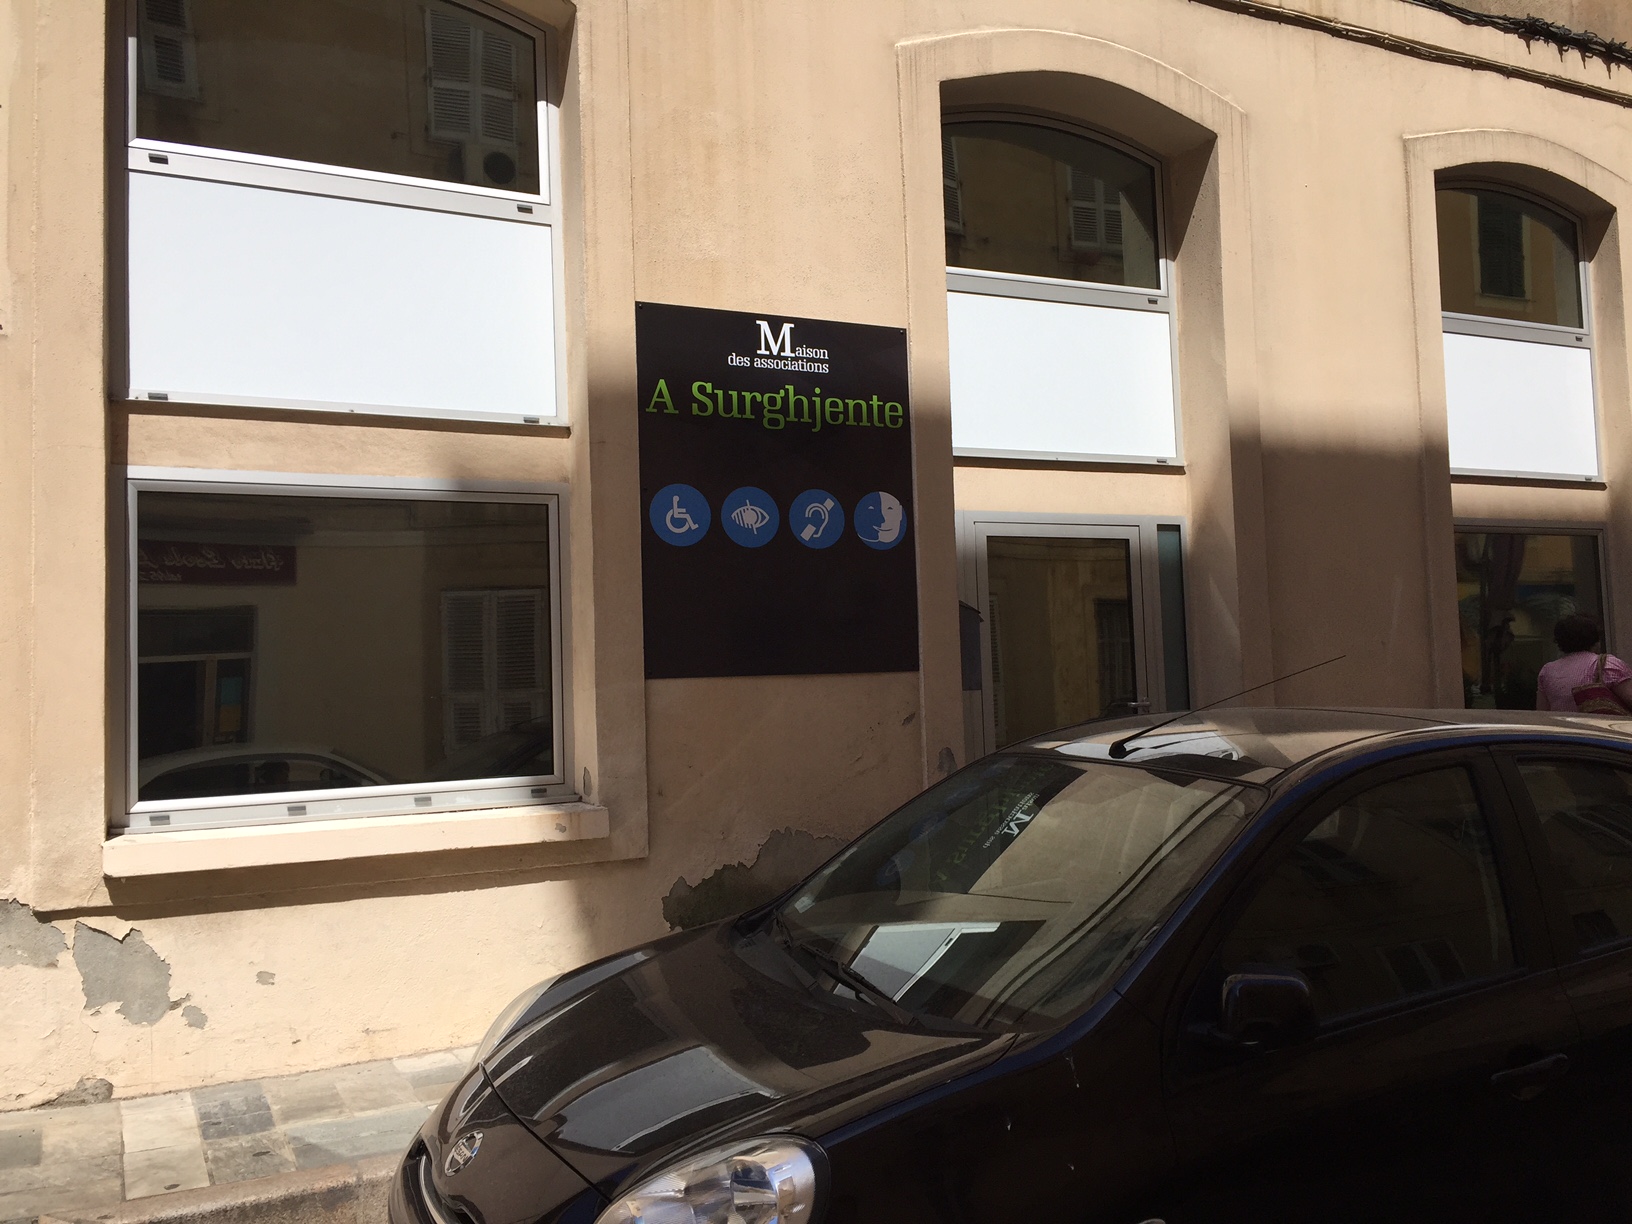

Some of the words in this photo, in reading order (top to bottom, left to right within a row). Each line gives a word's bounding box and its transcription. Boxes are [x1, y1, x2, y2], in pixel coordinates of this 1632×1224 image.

[756, 319, 830, 360] Maison
[728, 352, 750, 367] des
[754, 355, 830, 374] associations
[645, 378, 679, 414] A
[691, 381, 904, 432] Surghjente
